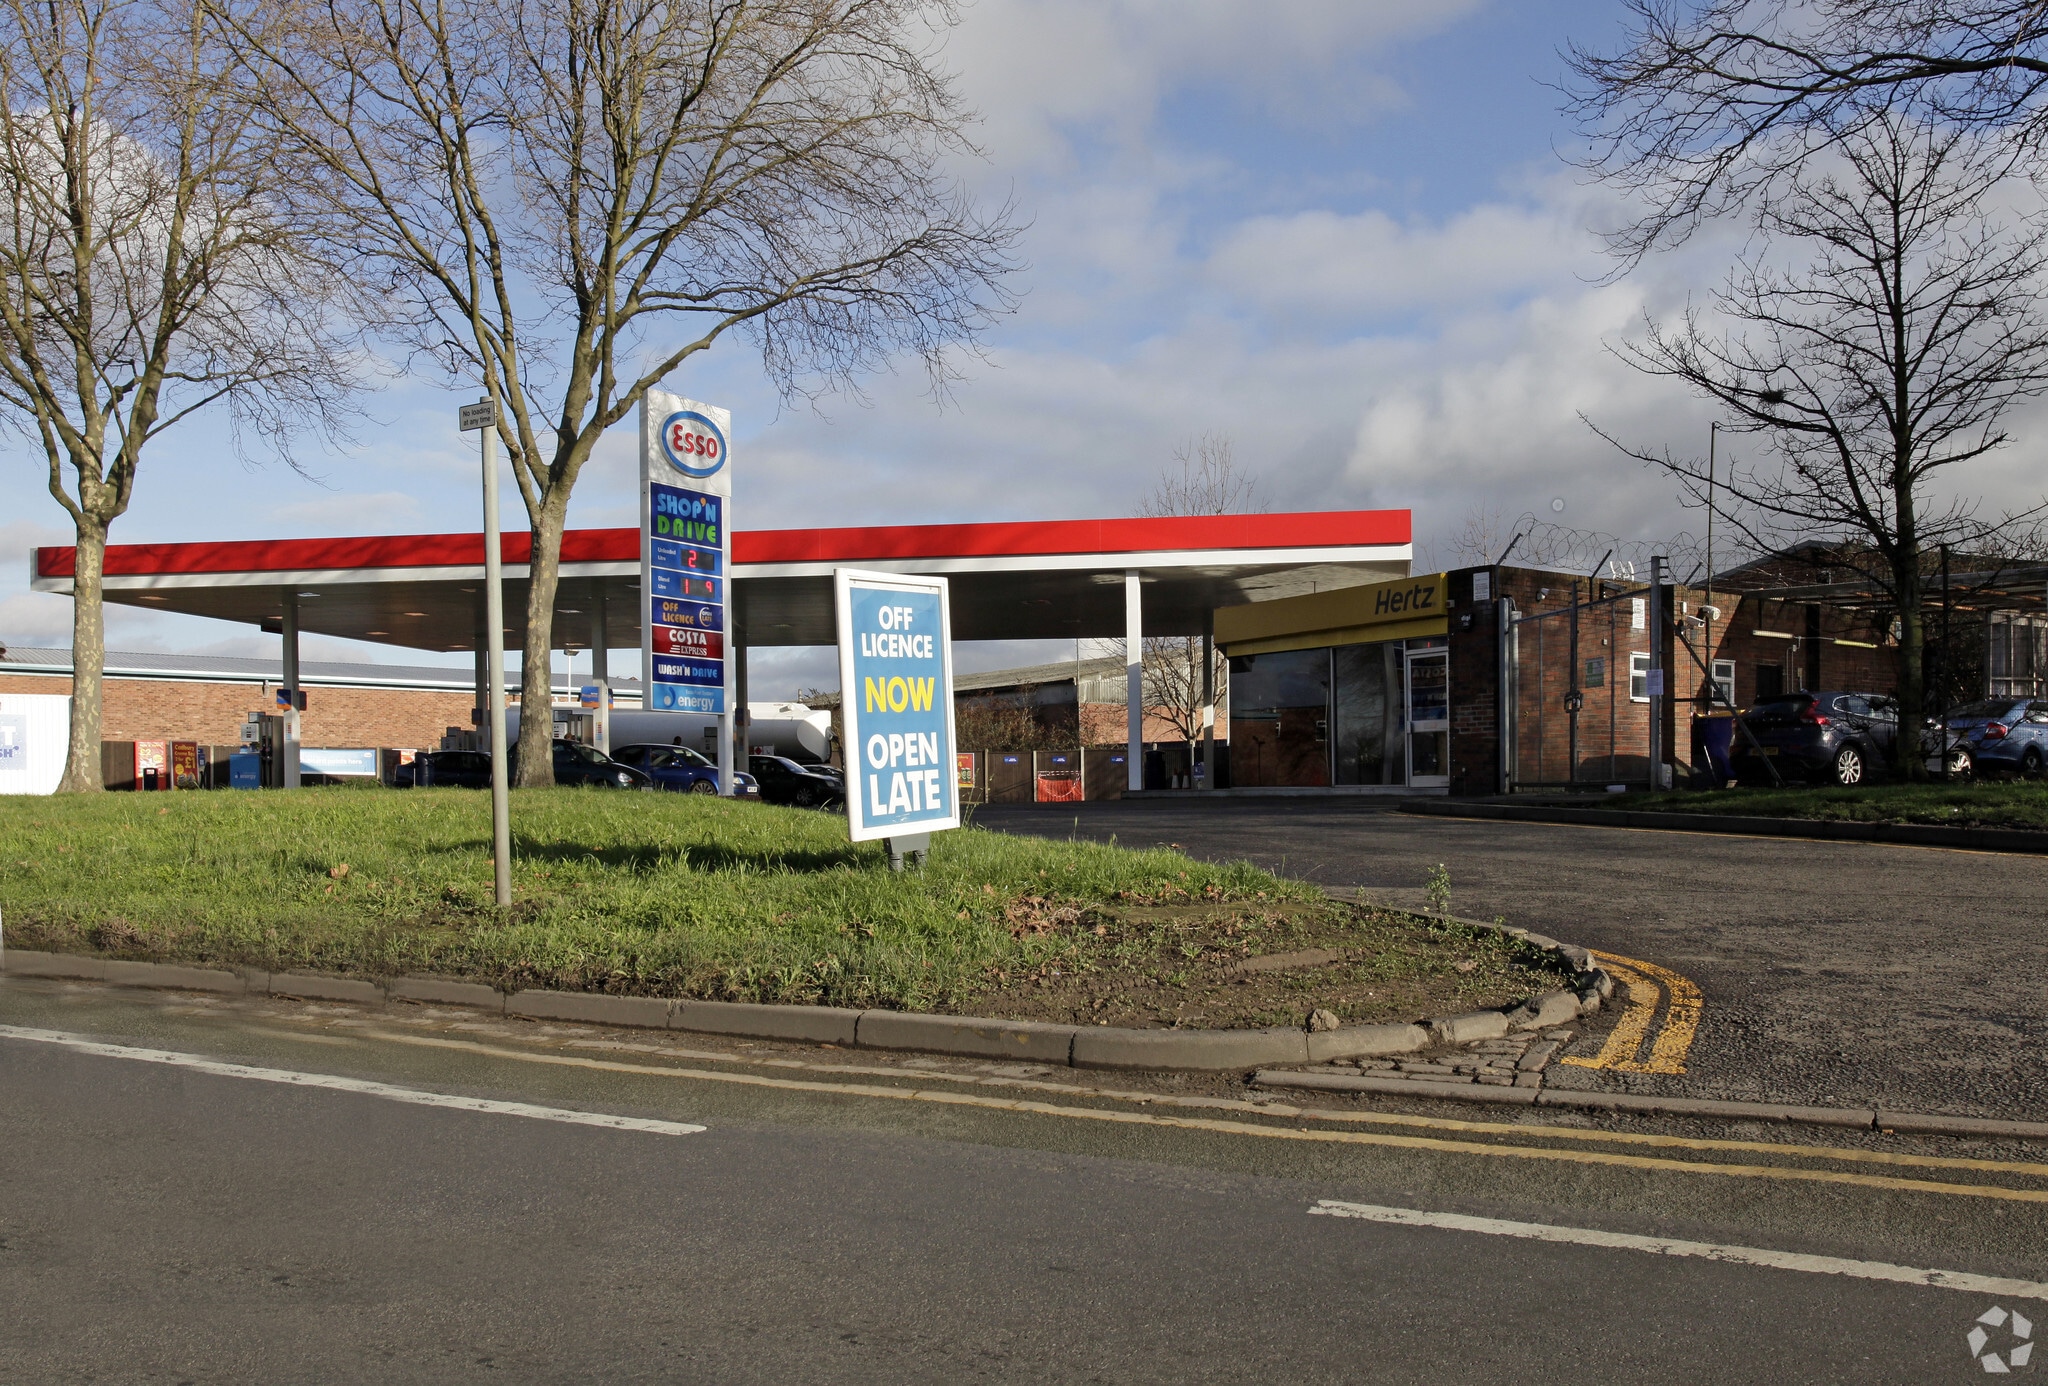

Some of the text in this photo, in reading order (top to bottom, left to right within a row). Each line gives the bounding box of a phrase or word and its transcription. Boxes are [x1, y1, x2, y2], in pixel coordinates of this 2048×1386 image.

[472, 406, 490, 415] loading
[658, 494, 716, 522] SHOP'N
[658, 514, 716, 544] DRIVE
[662, 602, 678, 612] OFF
[1375, 584, 1435, 614] Hertz
[662, 612, 694, 624] LICENCE
[878, 606, 913, 631] OFF
[669, 629, 707, 645] COSTA
[862, 633, 934, 658] LICENCE
[681, 646, 708, 656] EXPRESS
[692, 668, 718, 678] DRIVE
[865, 676, 935, 713] NOW
[185, 757, 196, 768] £1
[867, 732, 938, 769] OPEN
[869, 770, 940, 816] LATE
